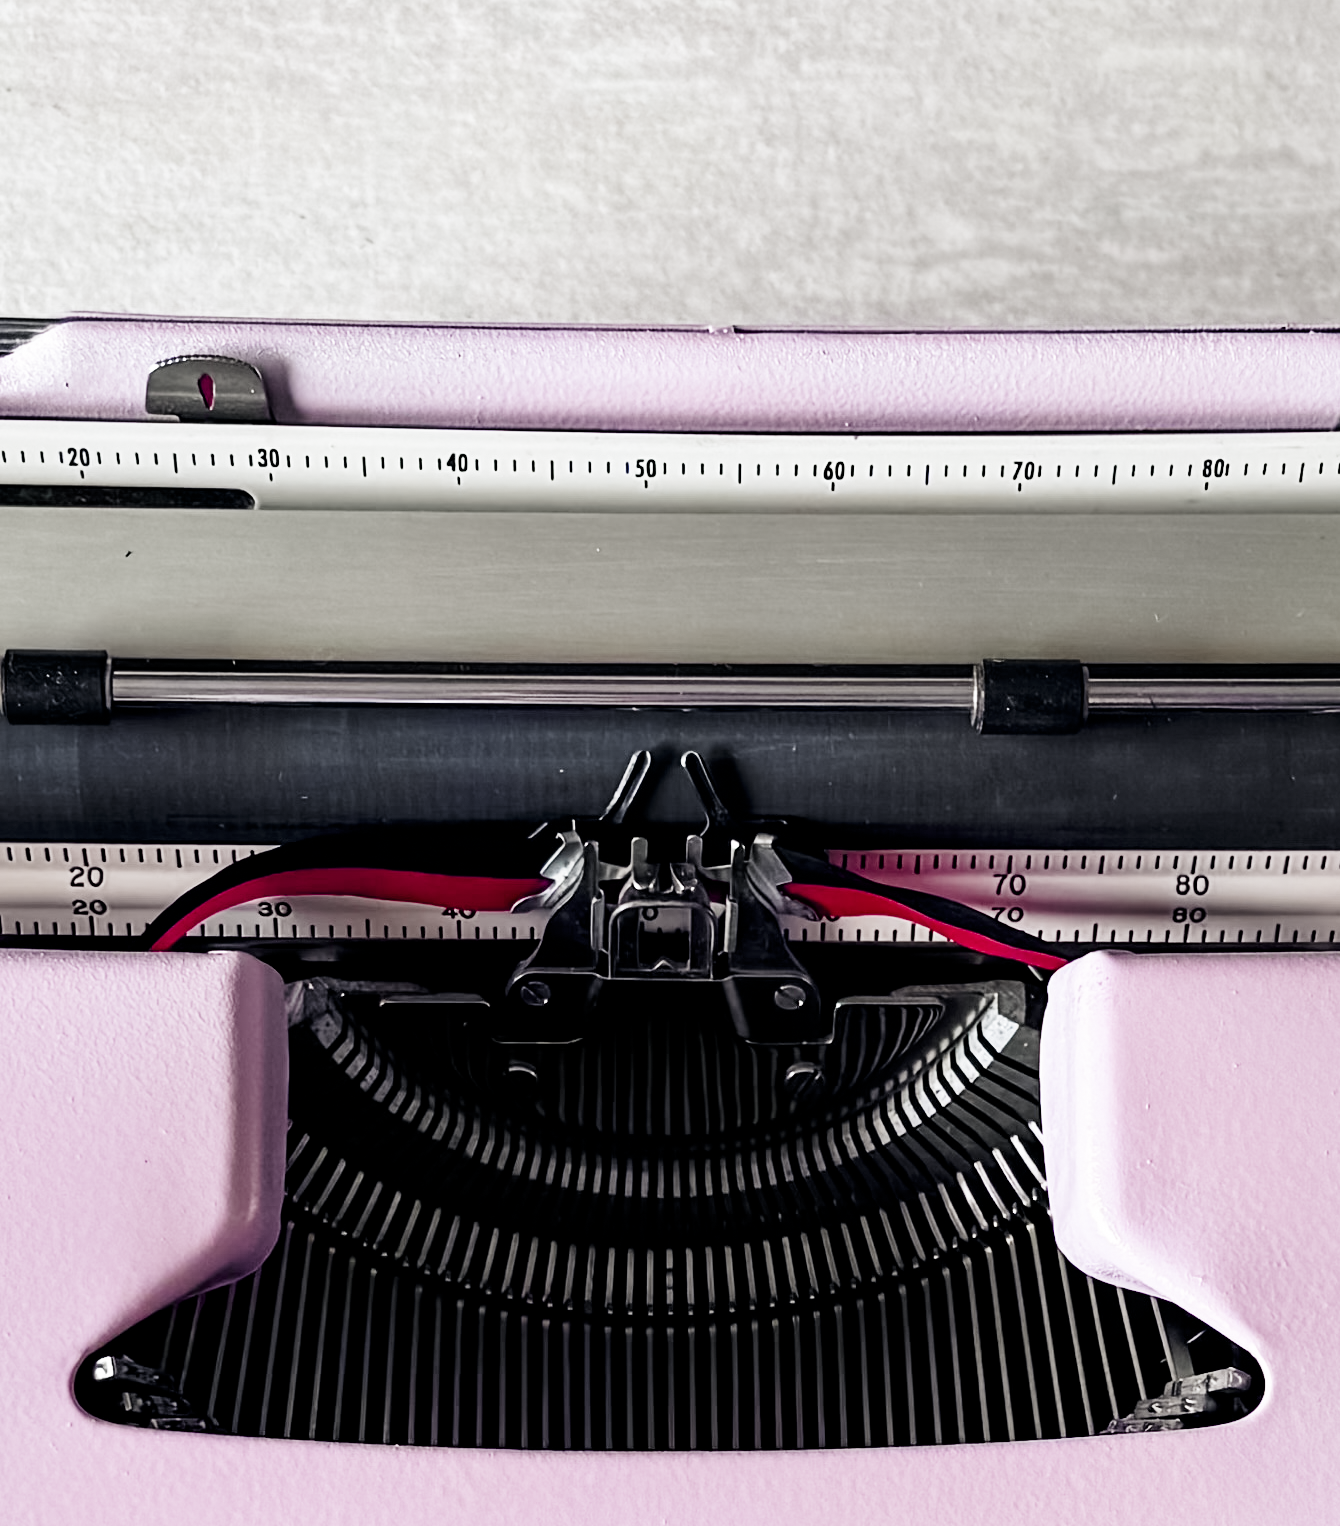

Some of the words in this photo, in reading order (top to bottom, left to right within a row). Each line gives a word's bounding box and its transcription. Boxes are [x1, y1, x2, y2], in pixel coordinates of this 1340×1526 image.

[67, 447, 90, 467] 20
[257, 448, 280, 468] 30
[446, 453, 468, 473] 40
[635, 458, 657, 478] 50
[823, 461, 845, 481] 60
[1012, 461, 1035, 481] 70
[1202, 458, 1225, 478] 80
[69, 865, 104, 888] 20
[992, 872, 1027, 897] 70
[1175, 874, 1210, 896] 80
[71, 899, 108, 916] 20
[257, 899, 295, 918] 30
[991, 906, 1025, 922] 70
[1171, 906, 1208, 924] 80
